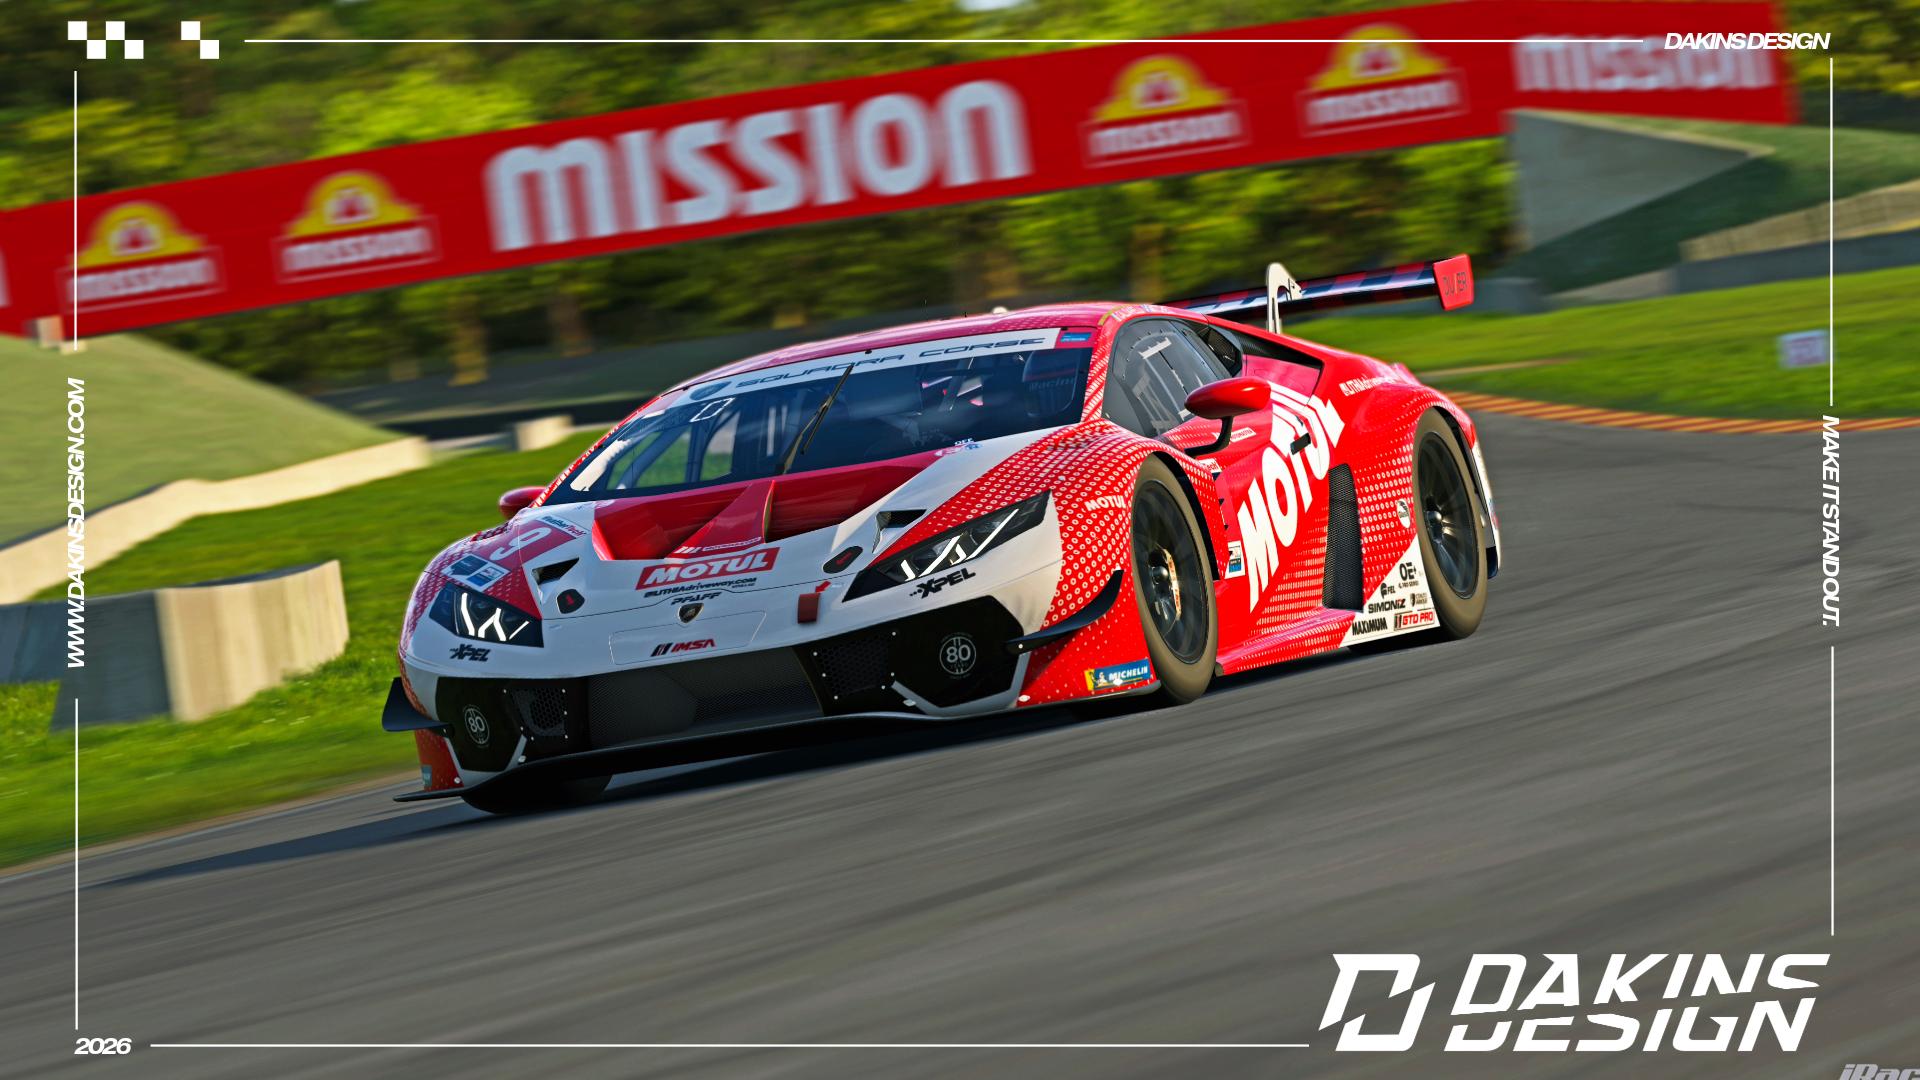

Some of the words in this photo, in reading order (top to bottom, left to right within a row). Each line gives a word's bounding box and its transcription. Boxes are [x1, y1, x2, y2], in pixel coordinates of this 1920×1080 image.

[482, 80, 1034, 252] MISSION
[735, 354, 905, 388] SQUADRA
[918, 337, 1046, 357] CORSE
[1084, 495, 1126, 511] MOTUL
[1237, 381, 1345, 614] MOTUL
[489, 526, 552, 561] 9
[643, 551, 769, 585] MOTUL
[914, 567, 977, 599] XPEL
[1352, 617, 1388, 636] MAXIMUM
[1402, 614, 1419, 626] GTD
[1420, 611, 1434, 622] PRO
[450, 643, 491, 662] XPEL
[671, 639, 716, 653] IMSA
[946, 644, 971, 663] 80
[1108, 666, 1148, 681] MICHELIN
[468, 716, 486, 732] 80
